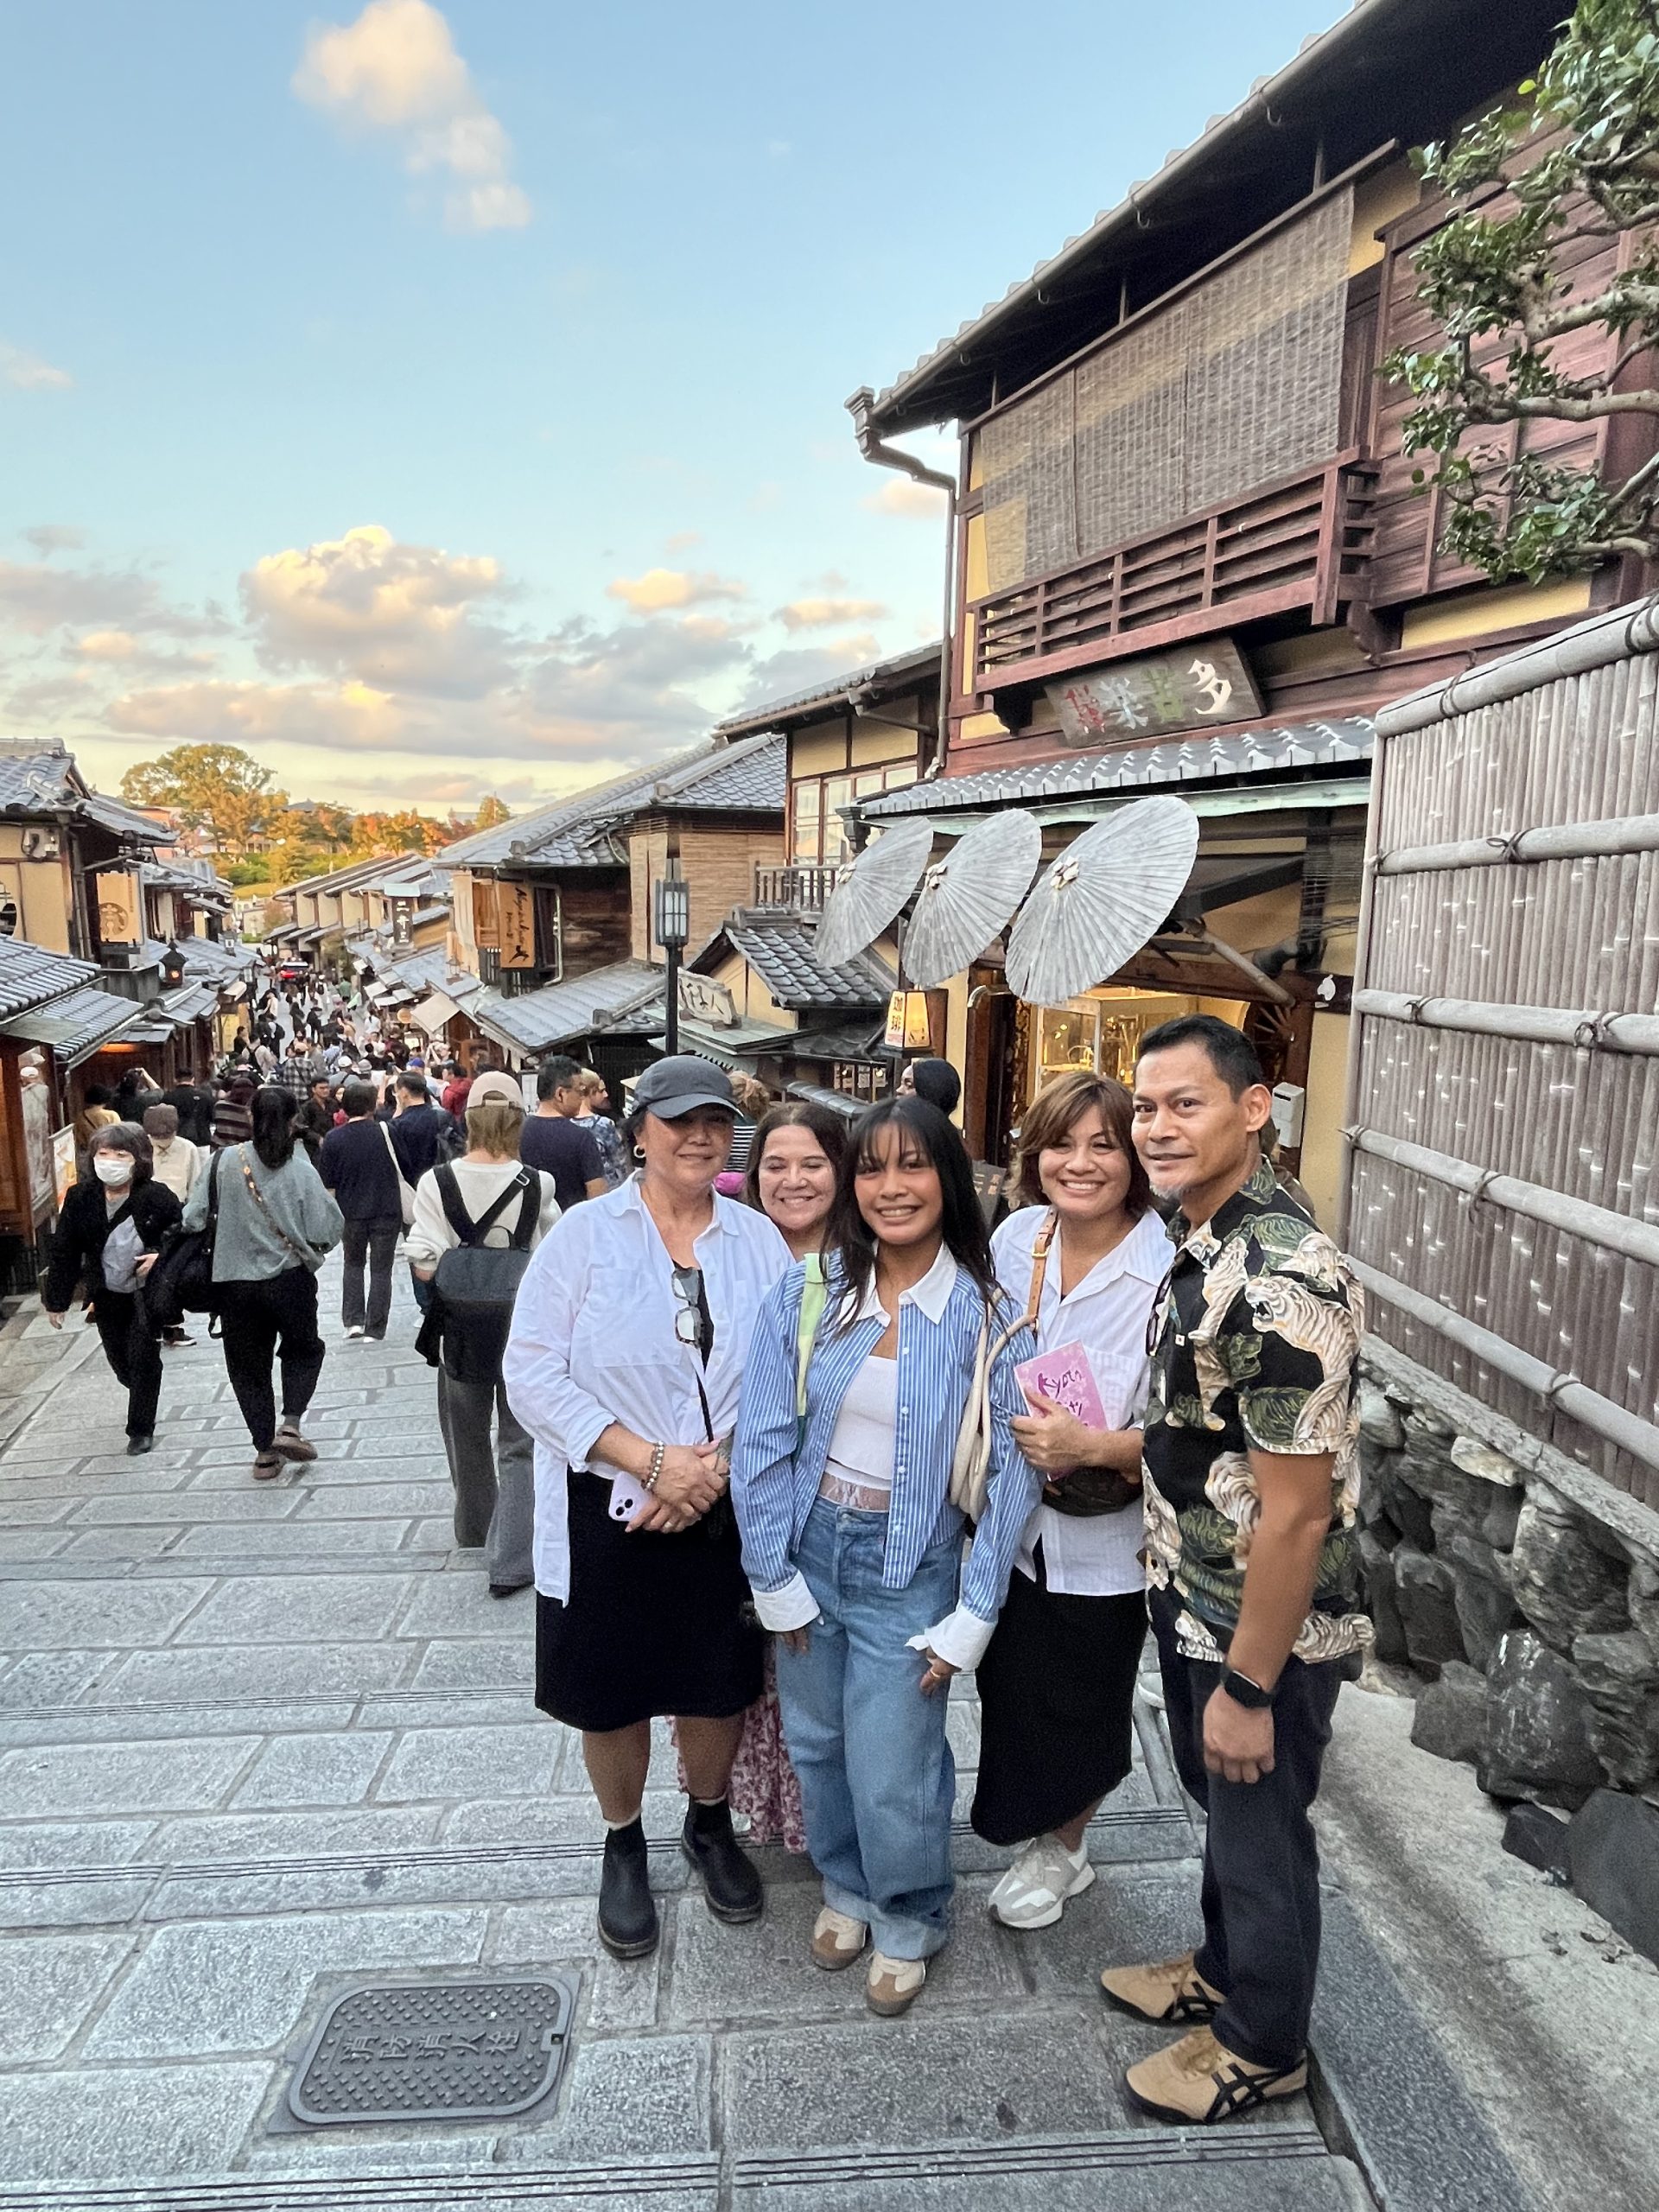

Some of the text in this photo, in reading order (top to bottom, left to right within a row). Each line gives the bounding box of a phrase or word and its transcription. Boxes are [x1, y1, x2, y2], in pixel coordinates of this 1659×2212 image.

[340, 2031, 518, 2063] 消防消火栓
